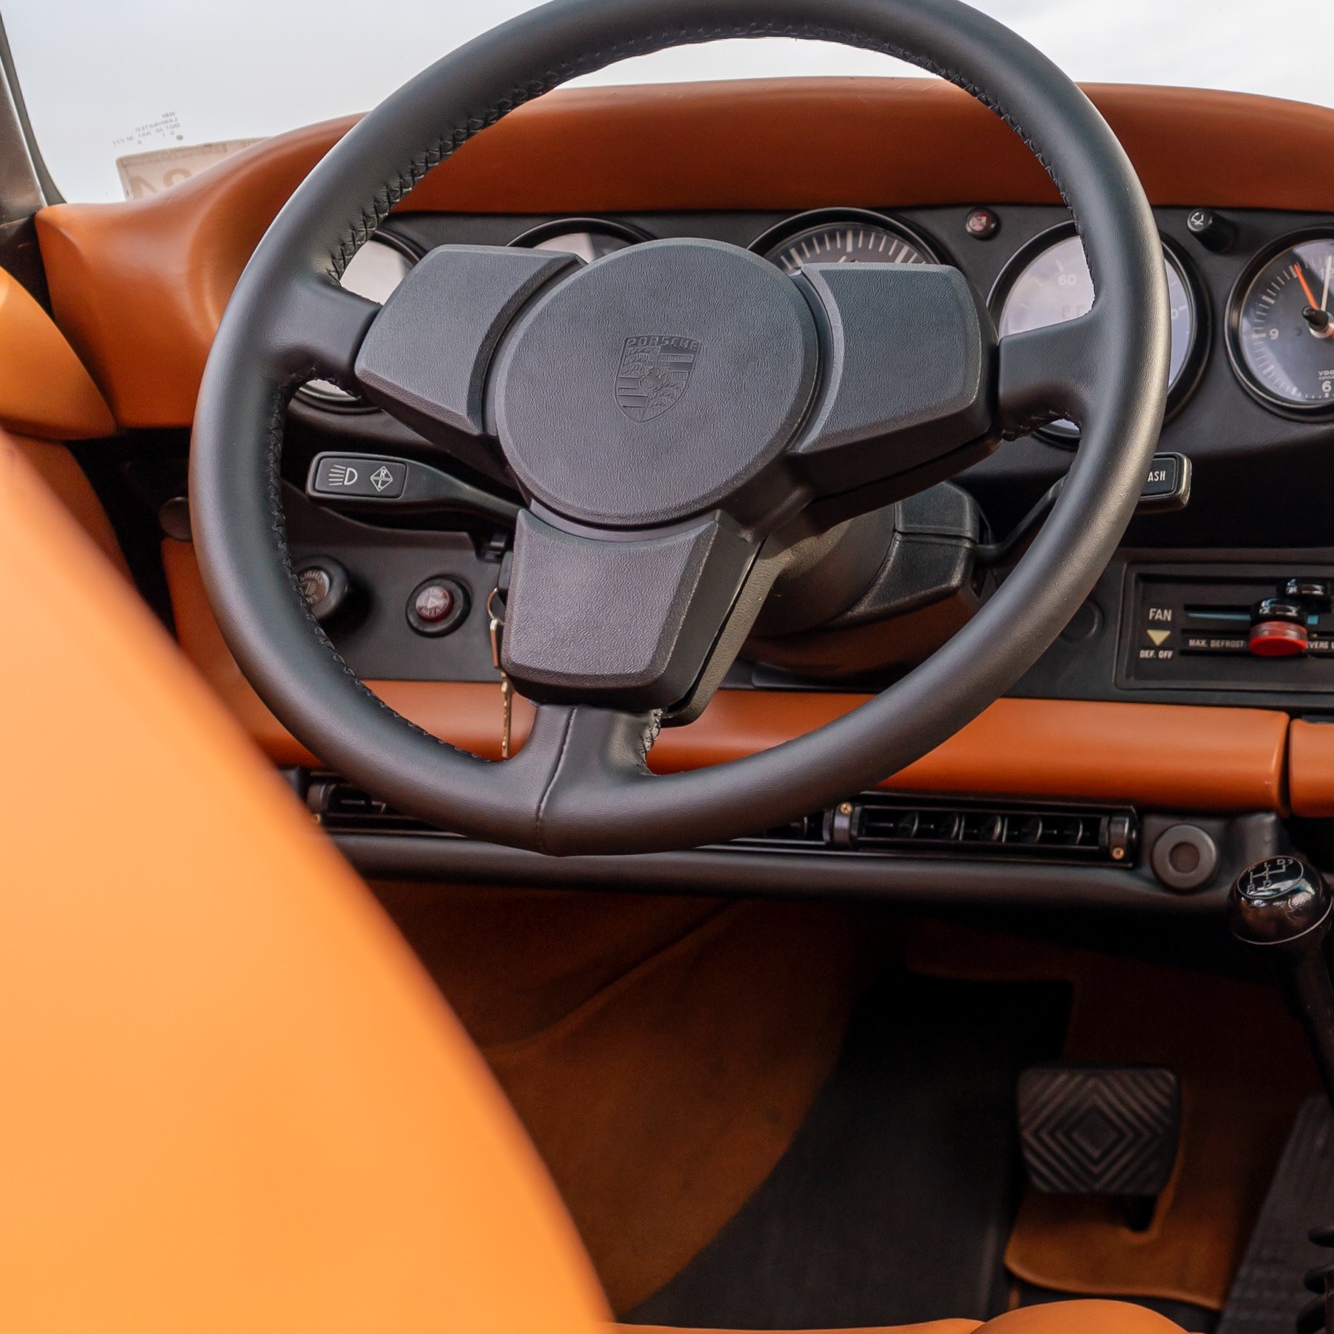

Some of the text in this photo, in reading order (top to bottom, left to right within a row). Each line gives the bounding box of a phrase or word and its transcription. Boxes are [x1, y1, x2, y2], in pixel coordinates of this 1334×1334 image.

[1058, 274, 1077, 285] 60
[1269, 328, 1279, 340] 9
[627, 336, 699, 351] PORSCHE
[1322, 380, 1332, 393] 6
[1147, 470, 1166, 482] ASH
[1148, 608, 1173, 621] FAN
[1189, 639, 1208, 647] MAX.
[1139, 650, 1174, 659] DEF. OFF
